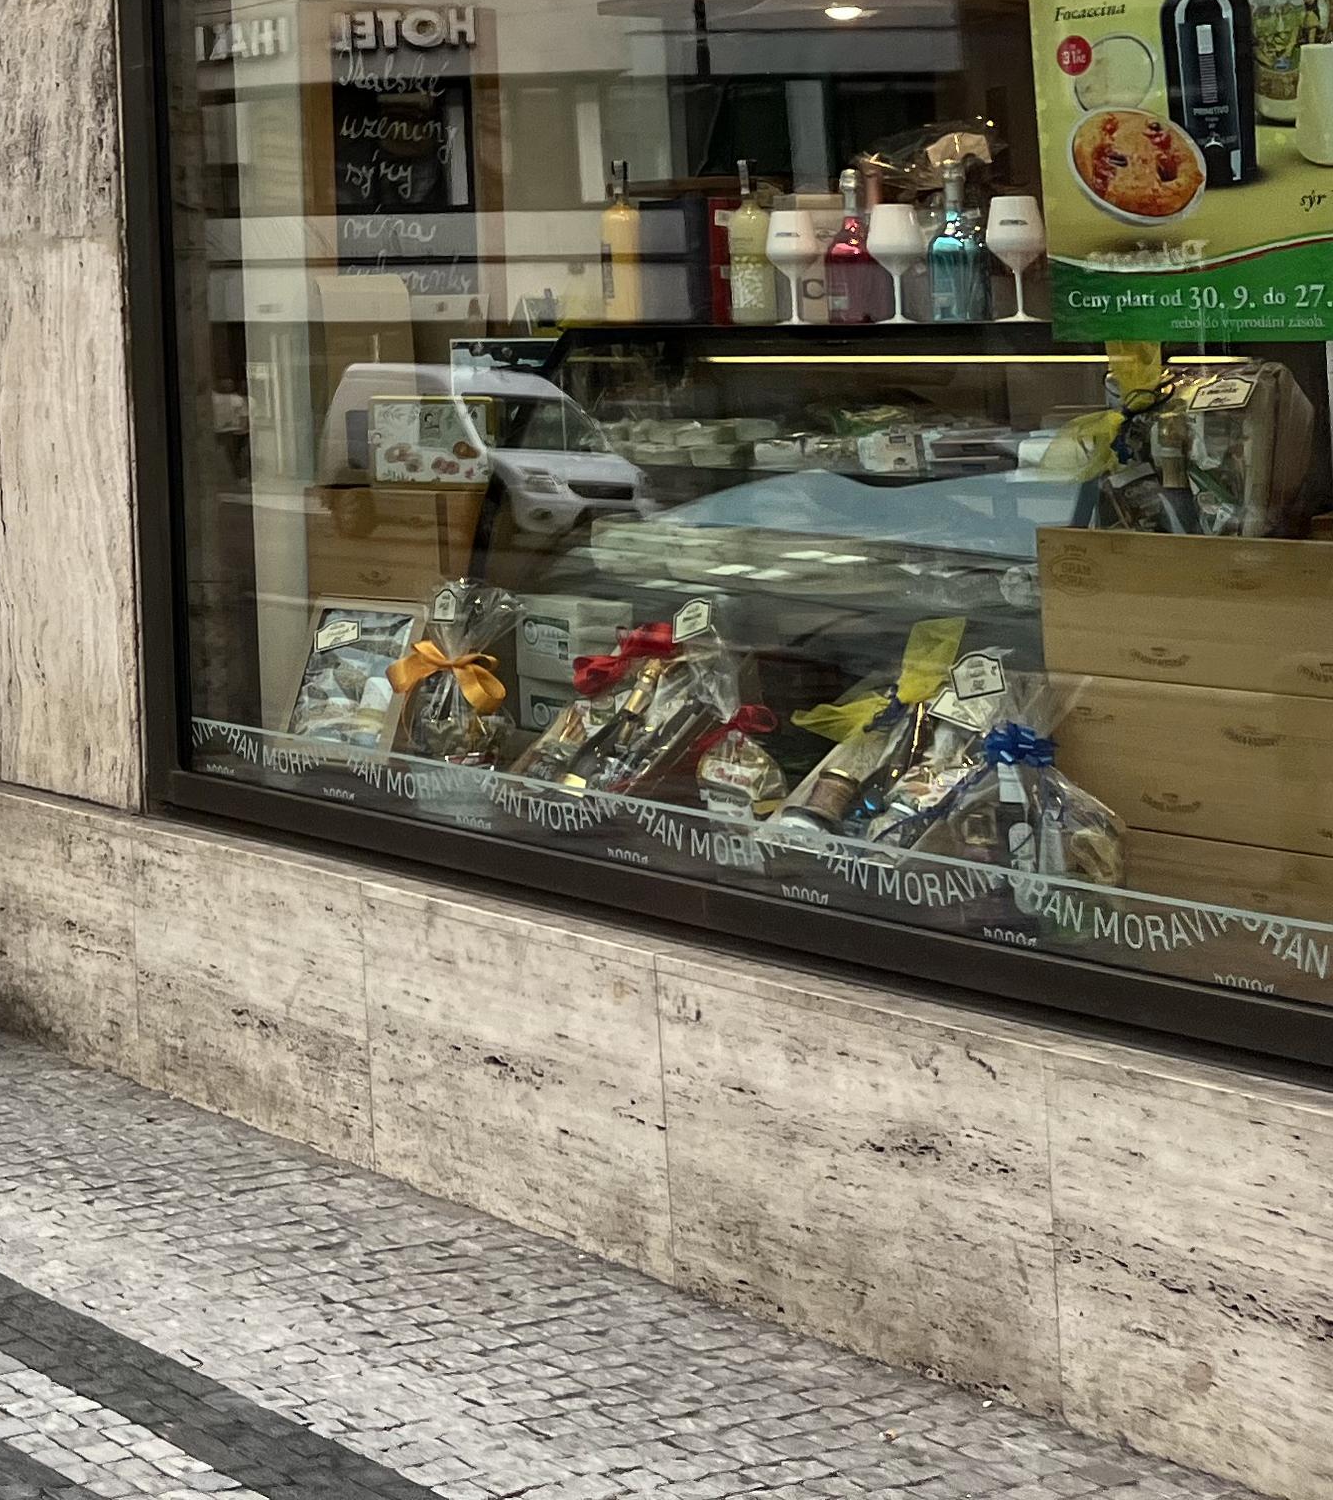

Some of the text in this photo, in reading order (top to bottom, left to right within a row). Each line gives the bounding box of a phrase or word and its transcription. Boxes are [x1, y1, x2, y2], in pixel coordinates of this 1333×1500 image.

[1054, 1, 1126, 23] Focaccina
[346, 150, 414, 199] sýry
[1300, 190, 1327, 212] sýr
[1068, 284, 1333, 313] Ceny platí od 30. 9. do 27.
